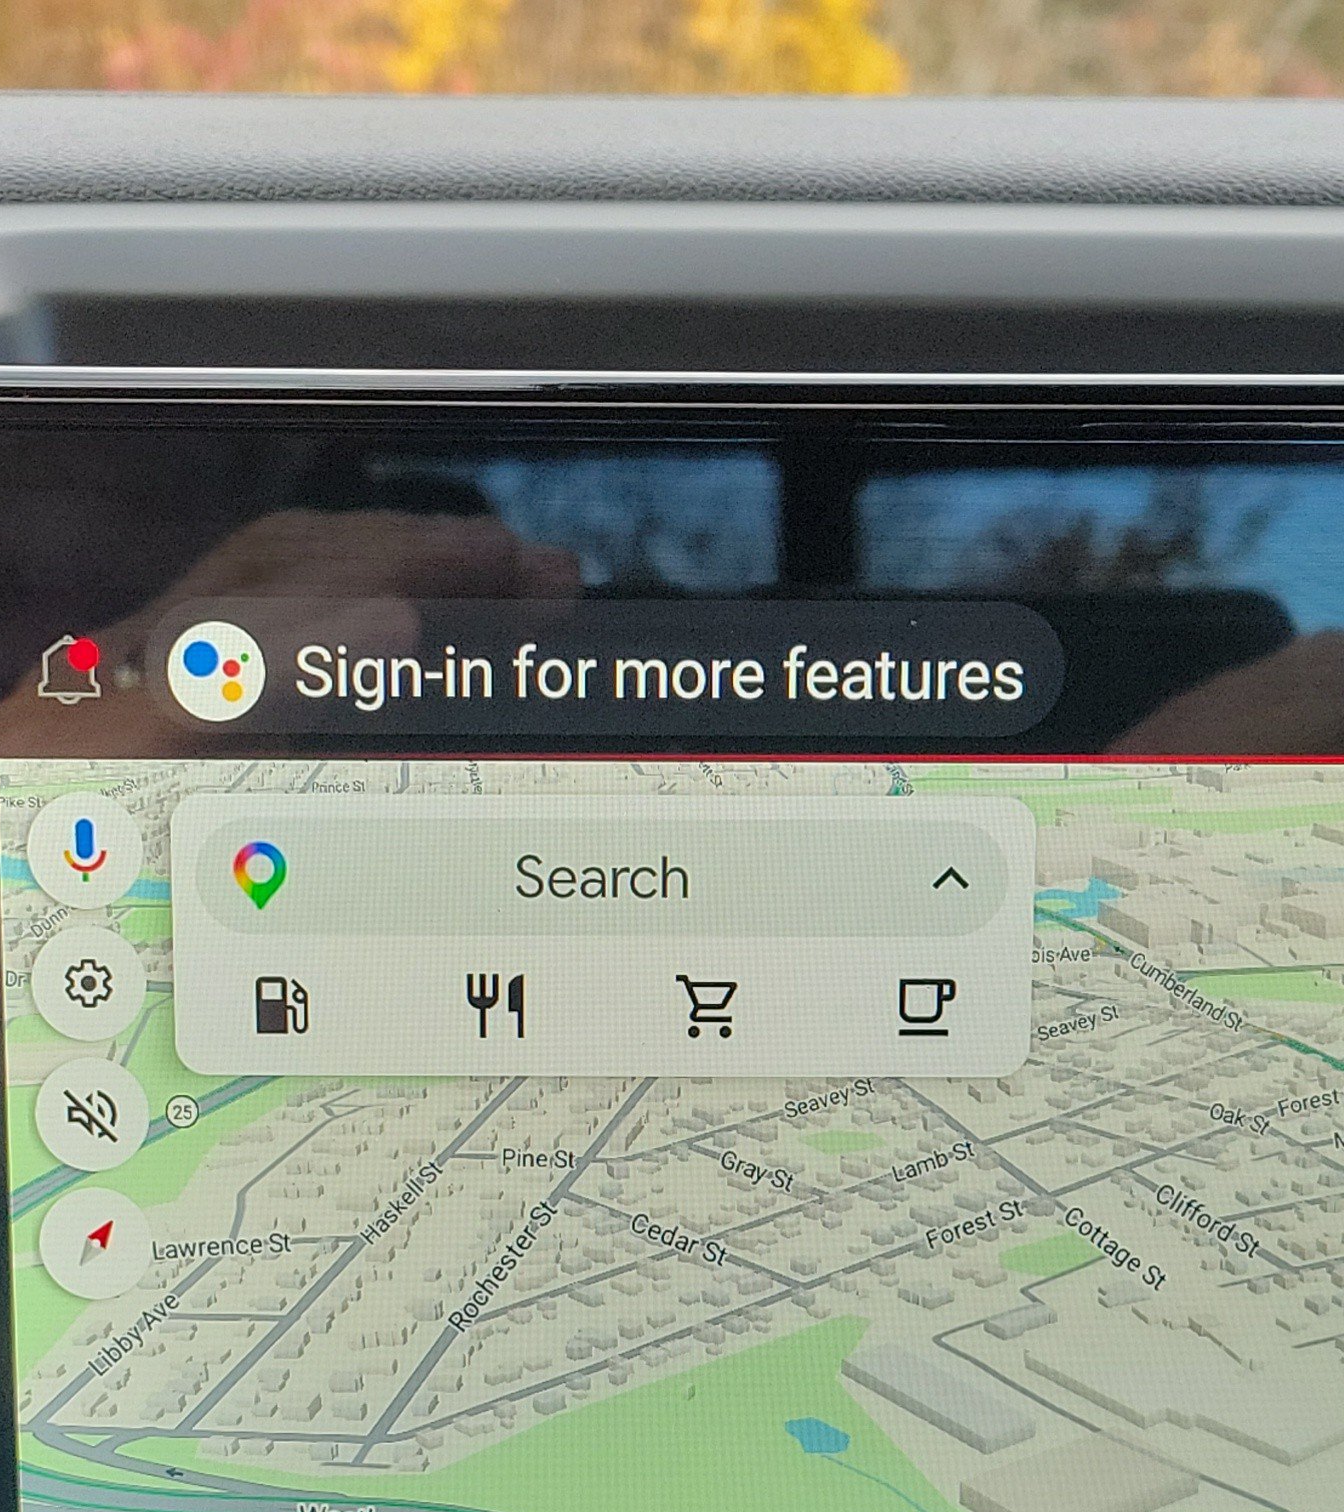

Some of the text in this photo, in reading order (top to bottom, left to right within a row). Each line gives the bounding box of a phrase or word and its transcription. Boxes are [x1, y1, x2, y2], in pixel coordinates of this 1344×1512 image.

[296, 643, 1024, 711] Sign-in for more features
[516, 854, 688, 899] Search
[1060, 947, 1091, 962] Ave
[1130, 952, 1243, 1032] Cumberland St
[1037, 1004, 1119, 1042] Seavey St
[172, 1105, 193, 1120] 25
[784, 1078, 875, 1119] Seavey St
[1209, 1103, 1270, 1136] Oak St
[1277, 1090, 1338, 1118] Forest
[501, 1148, 576, 1169] Pine St
[720, 1151, 794, 1192] Gray St
[892, 1141, 976, 1183] Lamb St
[360, 1160, 444, 1246] Haskell St
[1156, 1185, 1261, 1258] Clifford St
[630, 1213, 729, 1267] Cedar St
[926, 1200, 1024, 1250] Forest St
[152, 1233, 292, 1261] Lawrence St
[447, 1200, 558, 1333] Rochester St
[1063, 1207, 1168, 1290] Cottage St
[88, 1292, 181, 1377] Libby Ave
